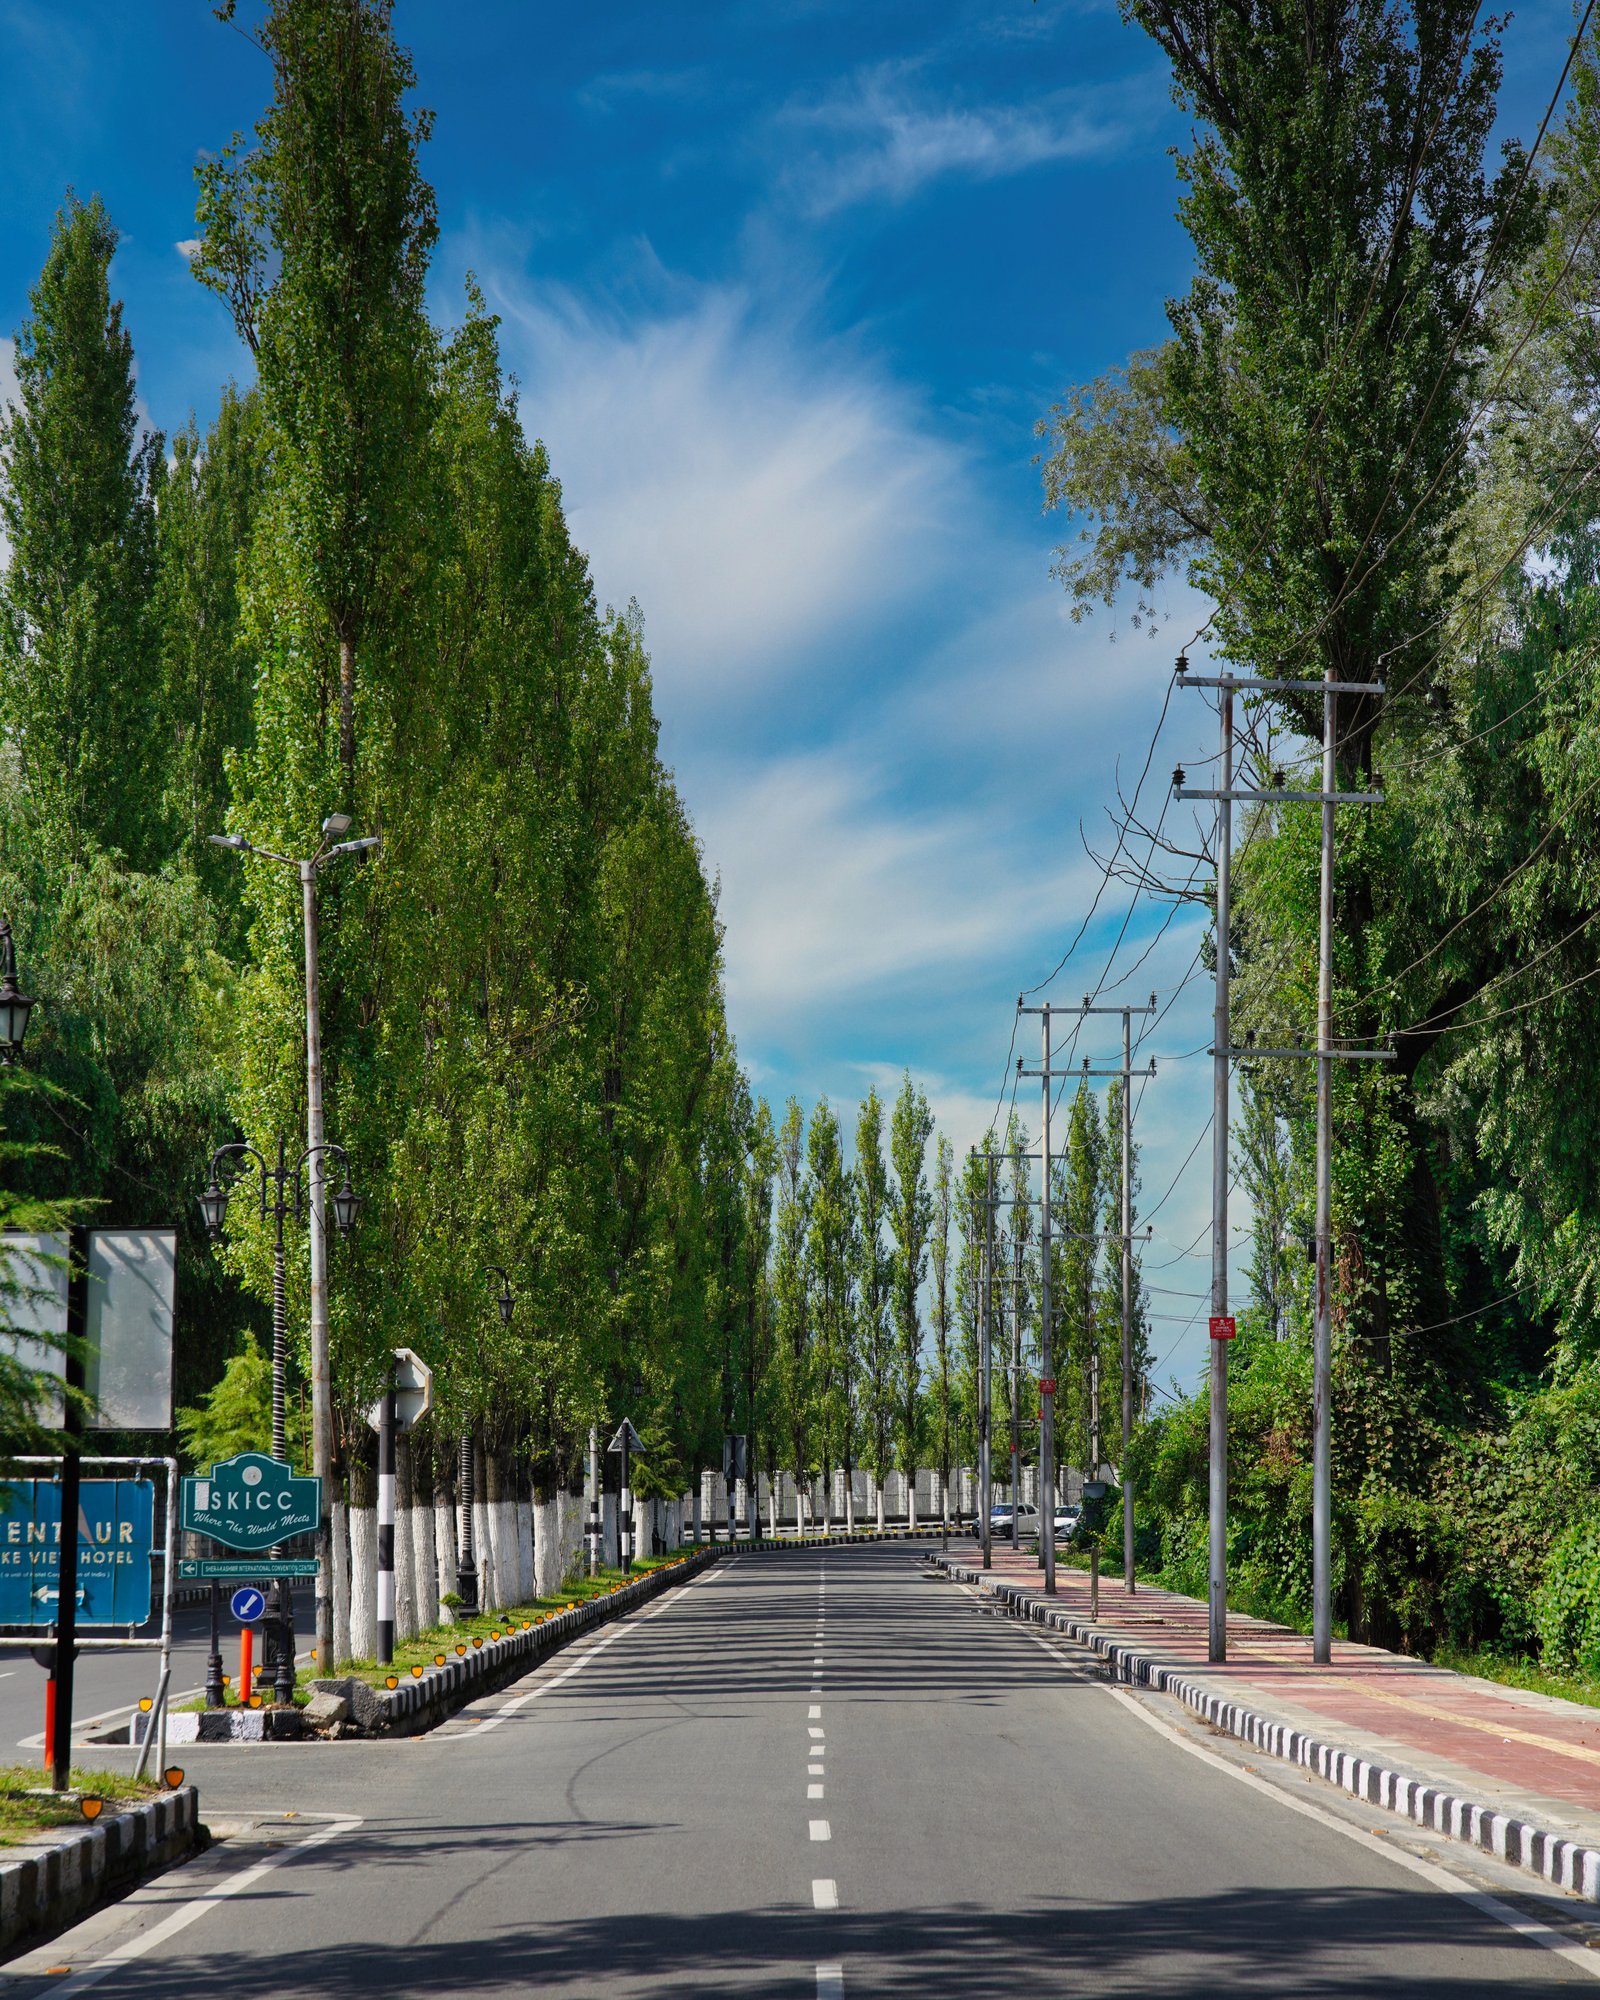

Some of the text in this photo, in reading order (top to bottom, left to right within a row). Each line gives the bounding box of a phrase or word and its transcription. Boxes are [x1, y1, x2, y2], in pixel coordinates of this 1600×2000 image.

[211, 1491, 293, 1510] SKICC
[193, 1511, 311, 1535] Where The World Meets
[29, 1551, 61, 1564] VIE
[81, 1551, 133, 1564] HOTEL
